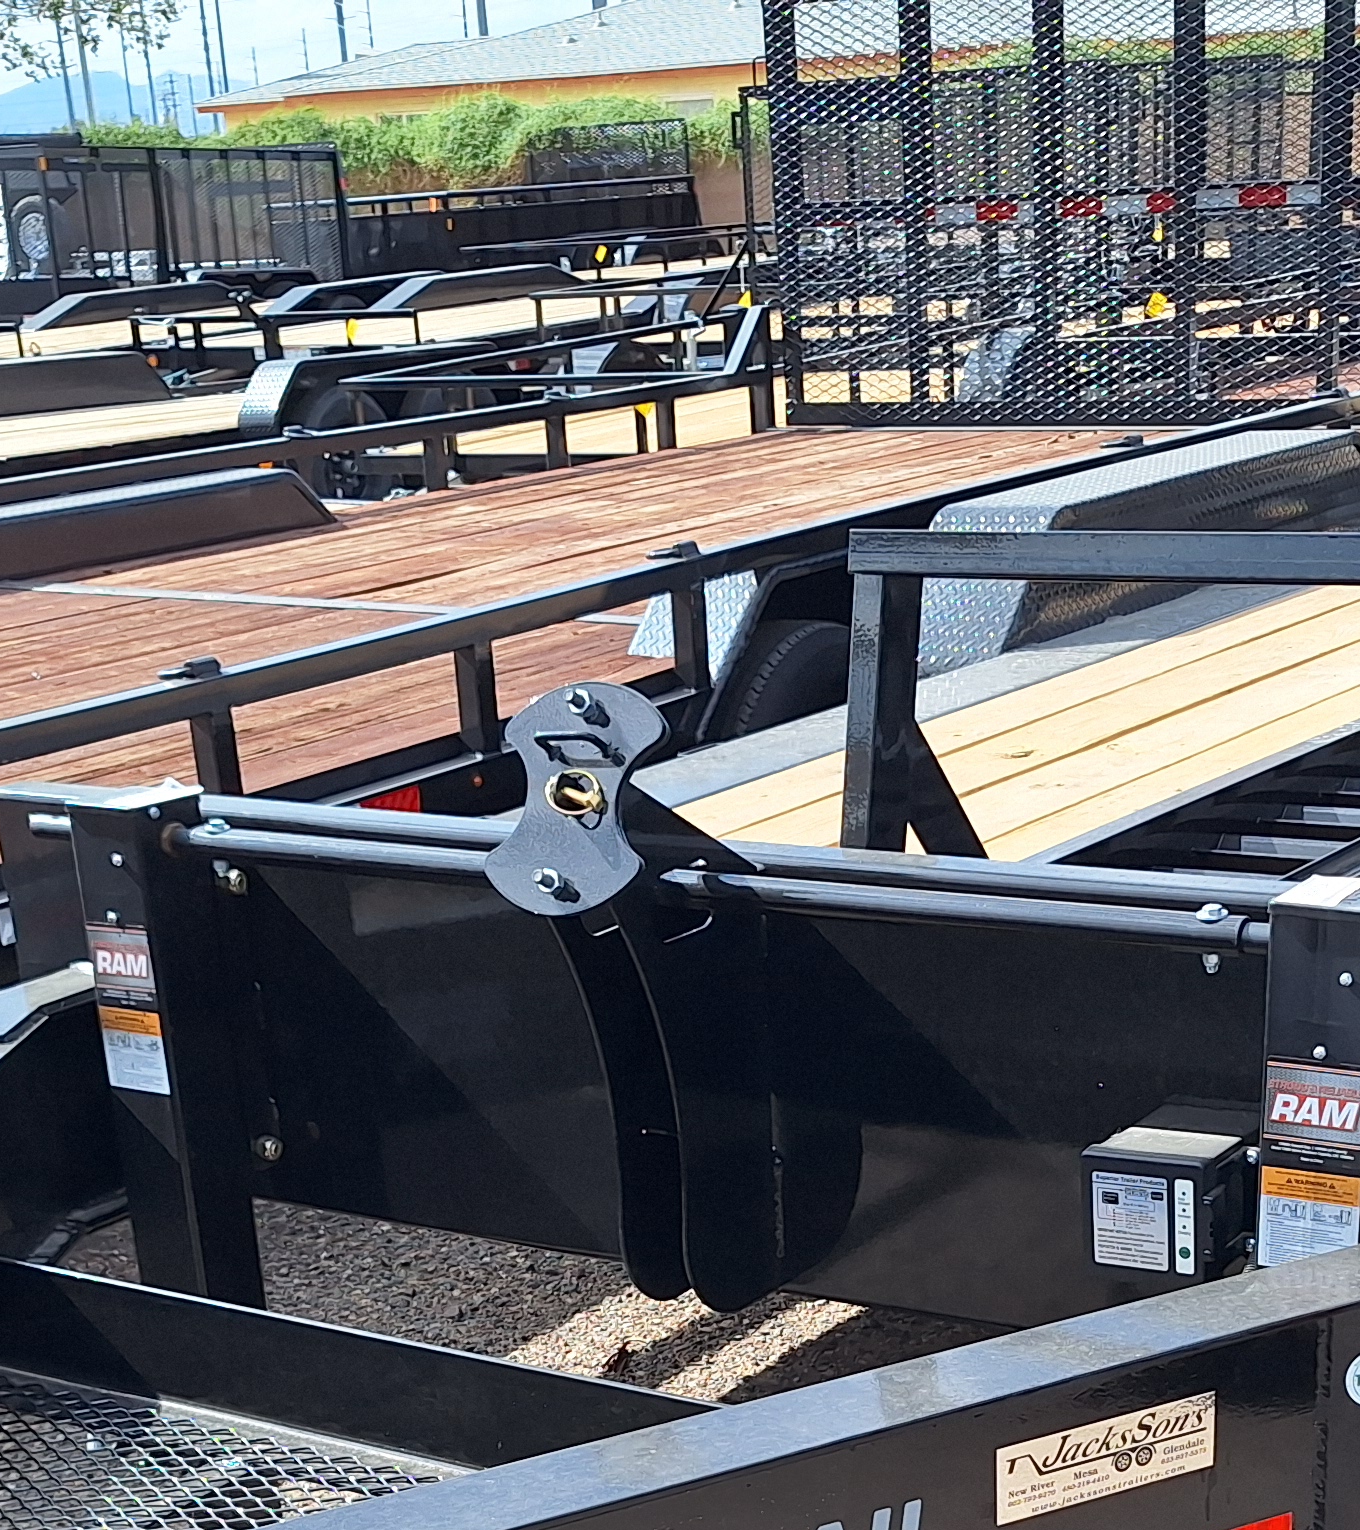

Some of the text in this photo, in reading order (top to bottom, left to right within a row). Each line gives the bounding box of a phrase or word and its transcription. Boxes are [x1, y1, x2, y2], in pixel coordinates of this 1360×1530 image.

[96, 949, 148, 978] RAM
[1270, 1092, 1360, 1130] RAM
[1163, 1438, 1205, 1455] Glendale
[1073, 1467, 1099, 1480] Mesa
[1007, 1480, 1056, 1500] New River
